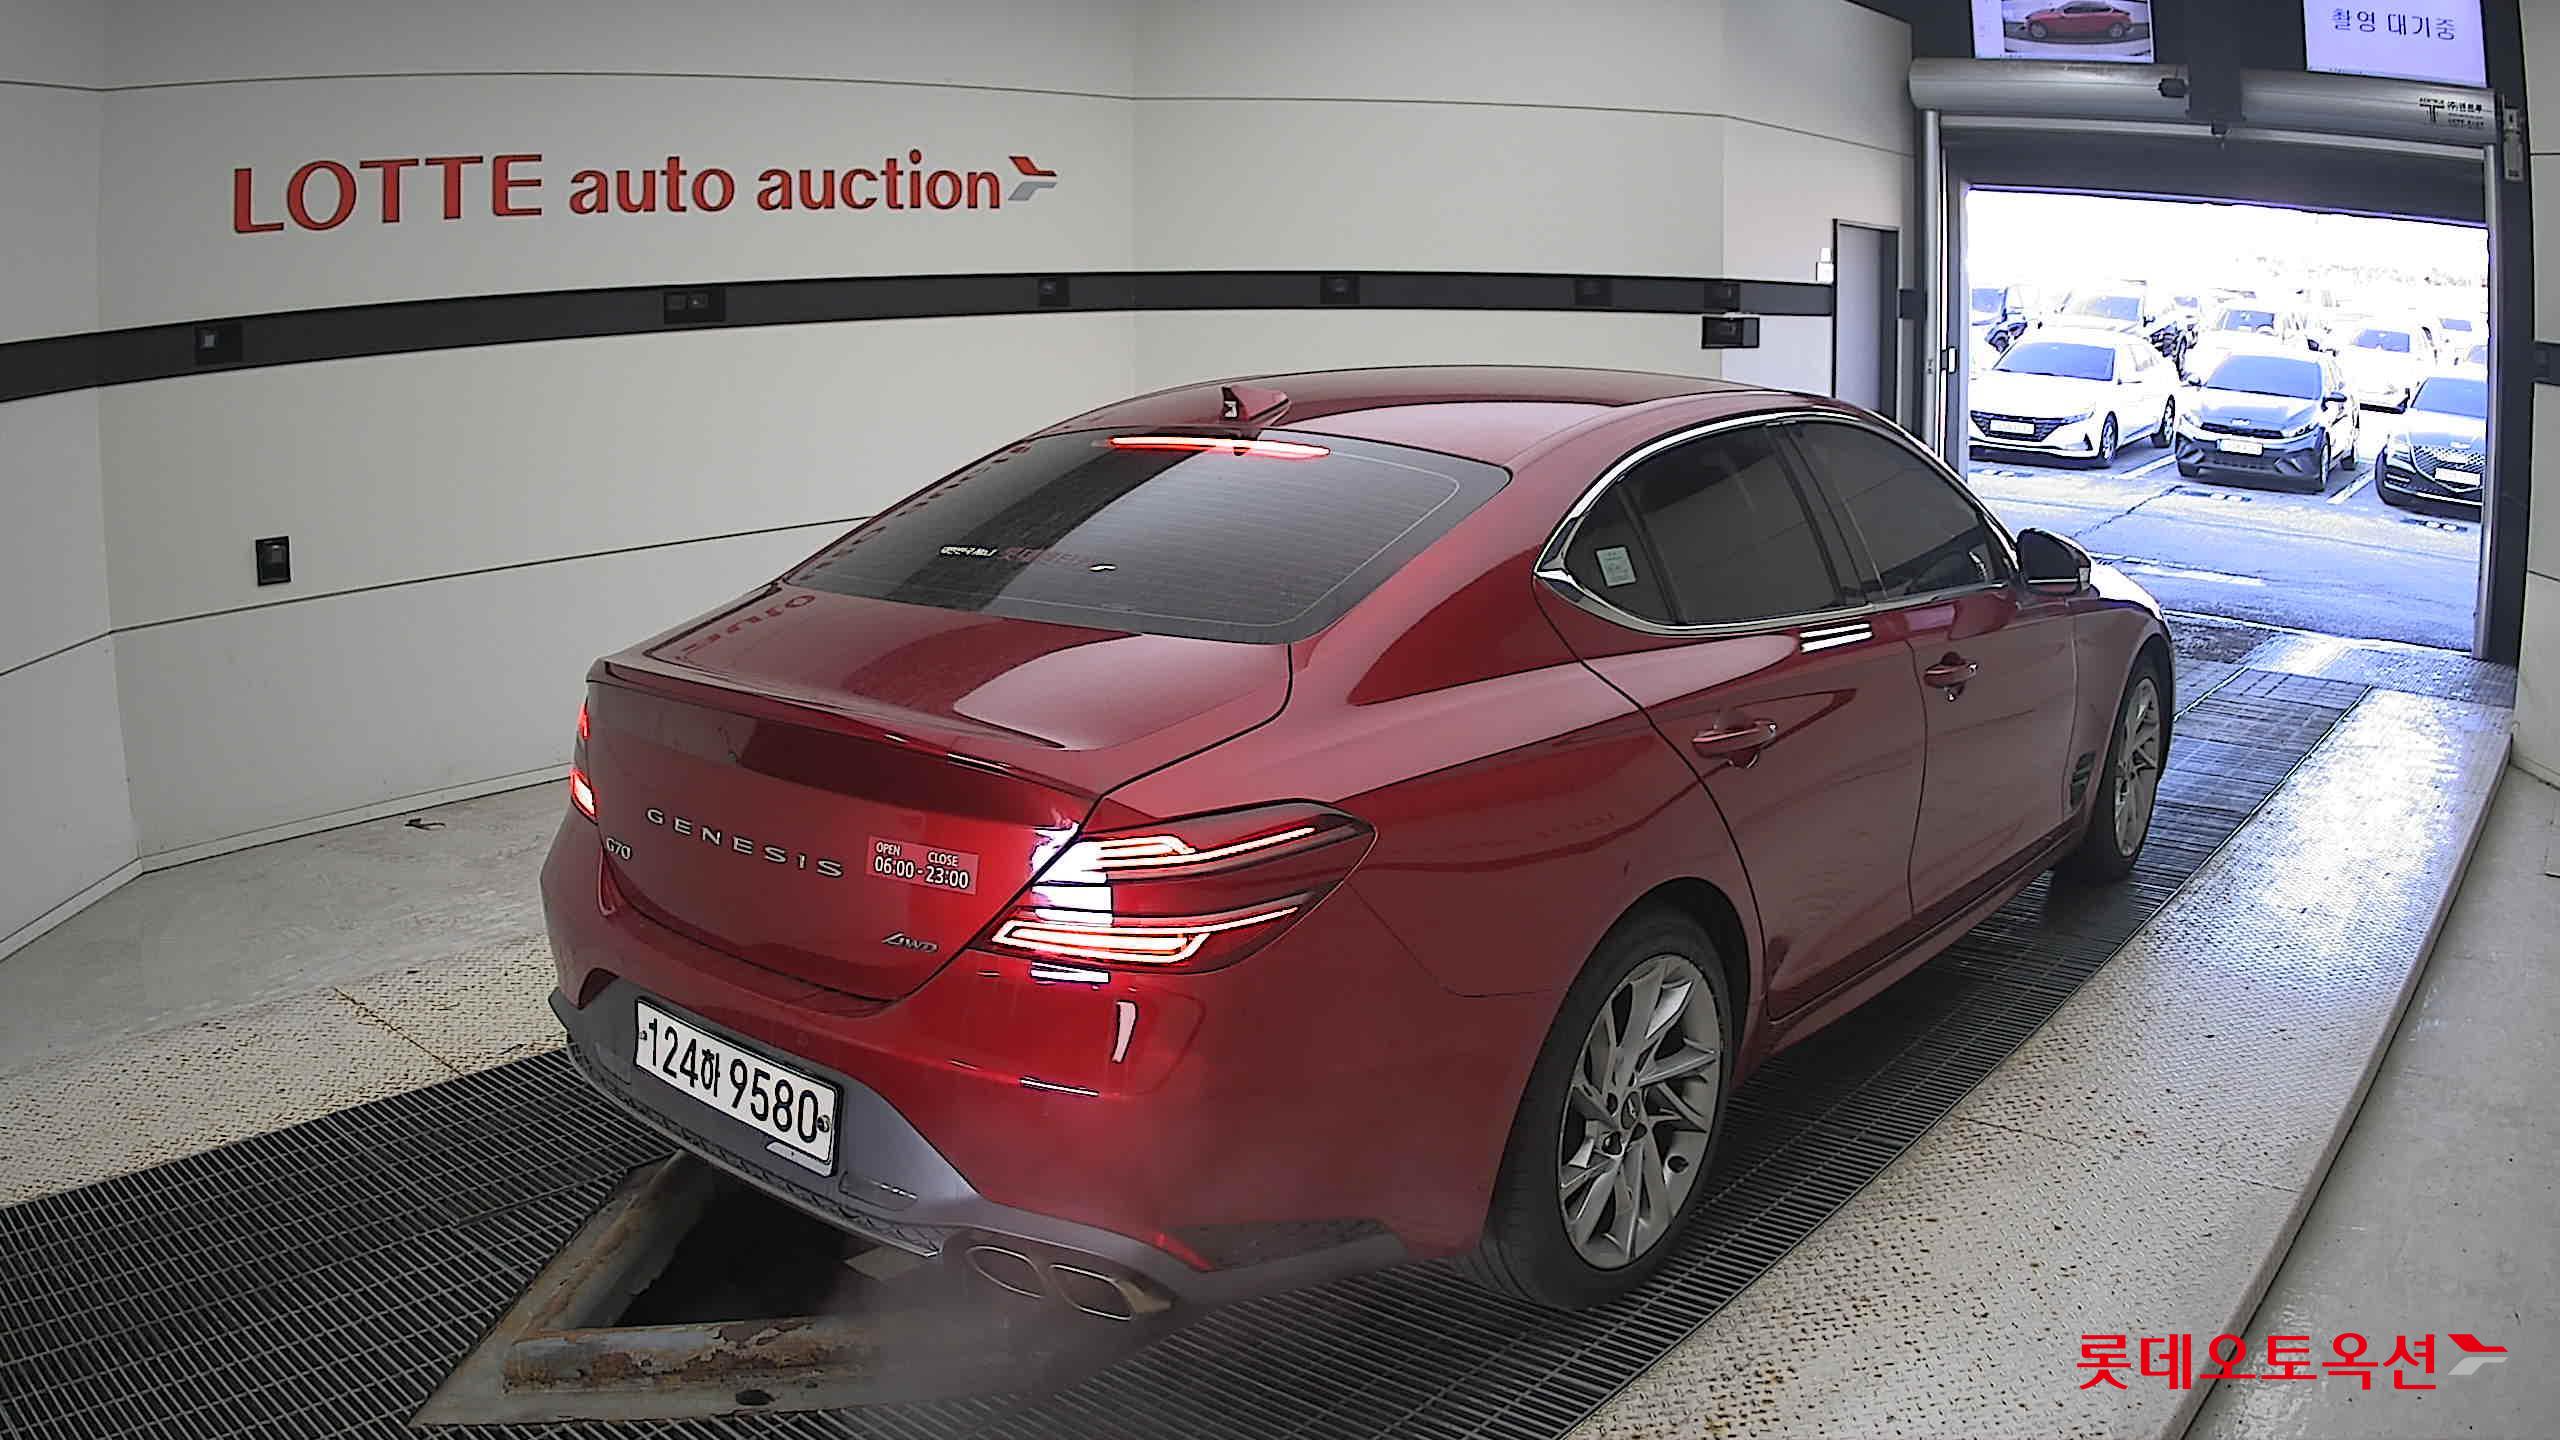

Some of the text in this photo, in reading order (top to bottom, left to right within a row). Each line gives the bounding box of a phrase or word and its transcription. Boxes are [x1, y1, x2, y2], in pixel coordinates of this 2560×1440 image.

[2331, 8, 2456, 41] 촬영 대기중
[233, 149, 1001, 234] LOTTE auto auction
[605, 838, 633, 861] G70
[646, 808, 845, 879] GENESIS
[875, 842, 960, 867] OPEN CLOSE
[874, 856, 915, 879] 06:00
[925, 866, 970, 889] 23:00
[648, 1018, 820, 1144] 124하 9580
